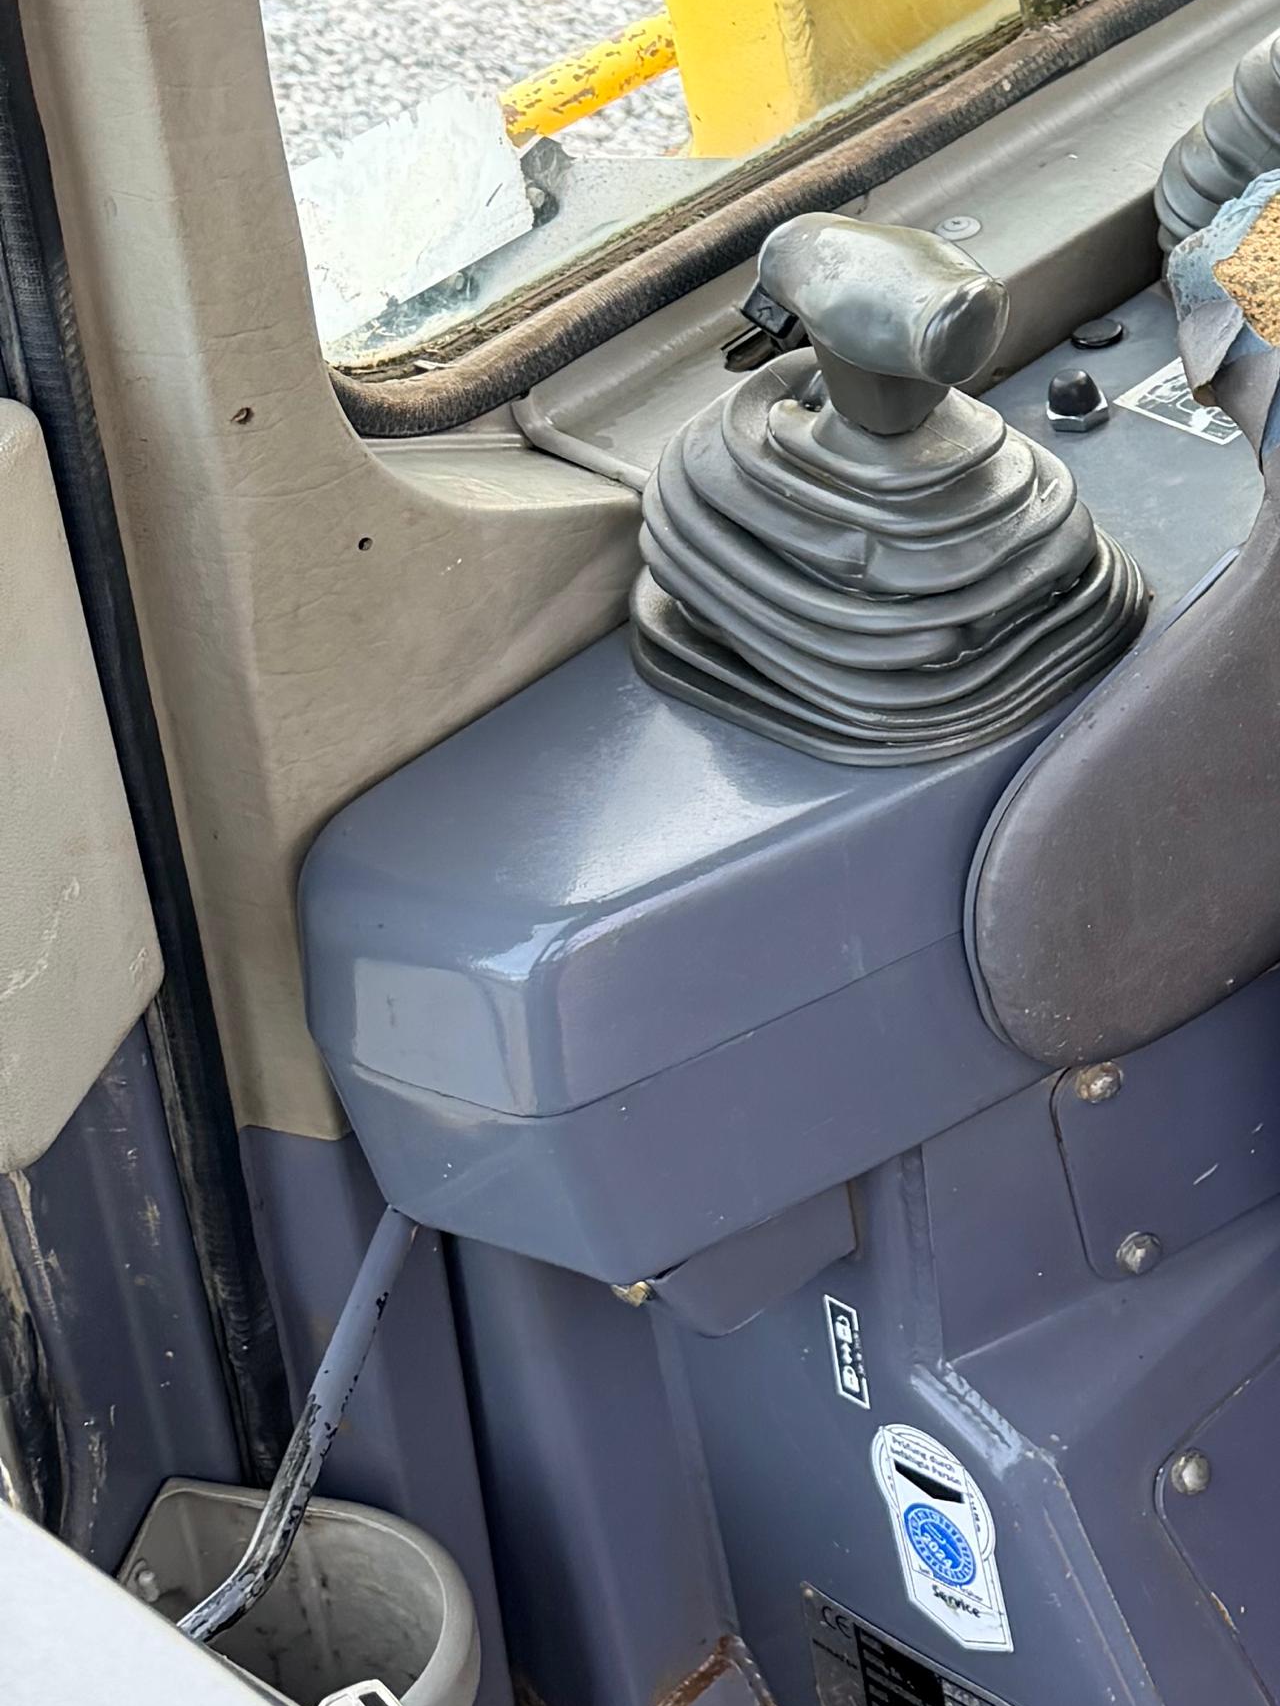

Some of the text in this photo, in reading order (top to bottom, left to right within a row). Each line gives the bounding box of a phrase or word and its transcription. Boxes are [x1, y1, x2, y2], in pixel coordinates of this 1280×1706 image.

[929, 1454, 956, 1474] durch
[931, 1465, 962, 1486] Person
[920, 1532, 953, 1569] 2024
[931, 1583, 982, 1619] Service
